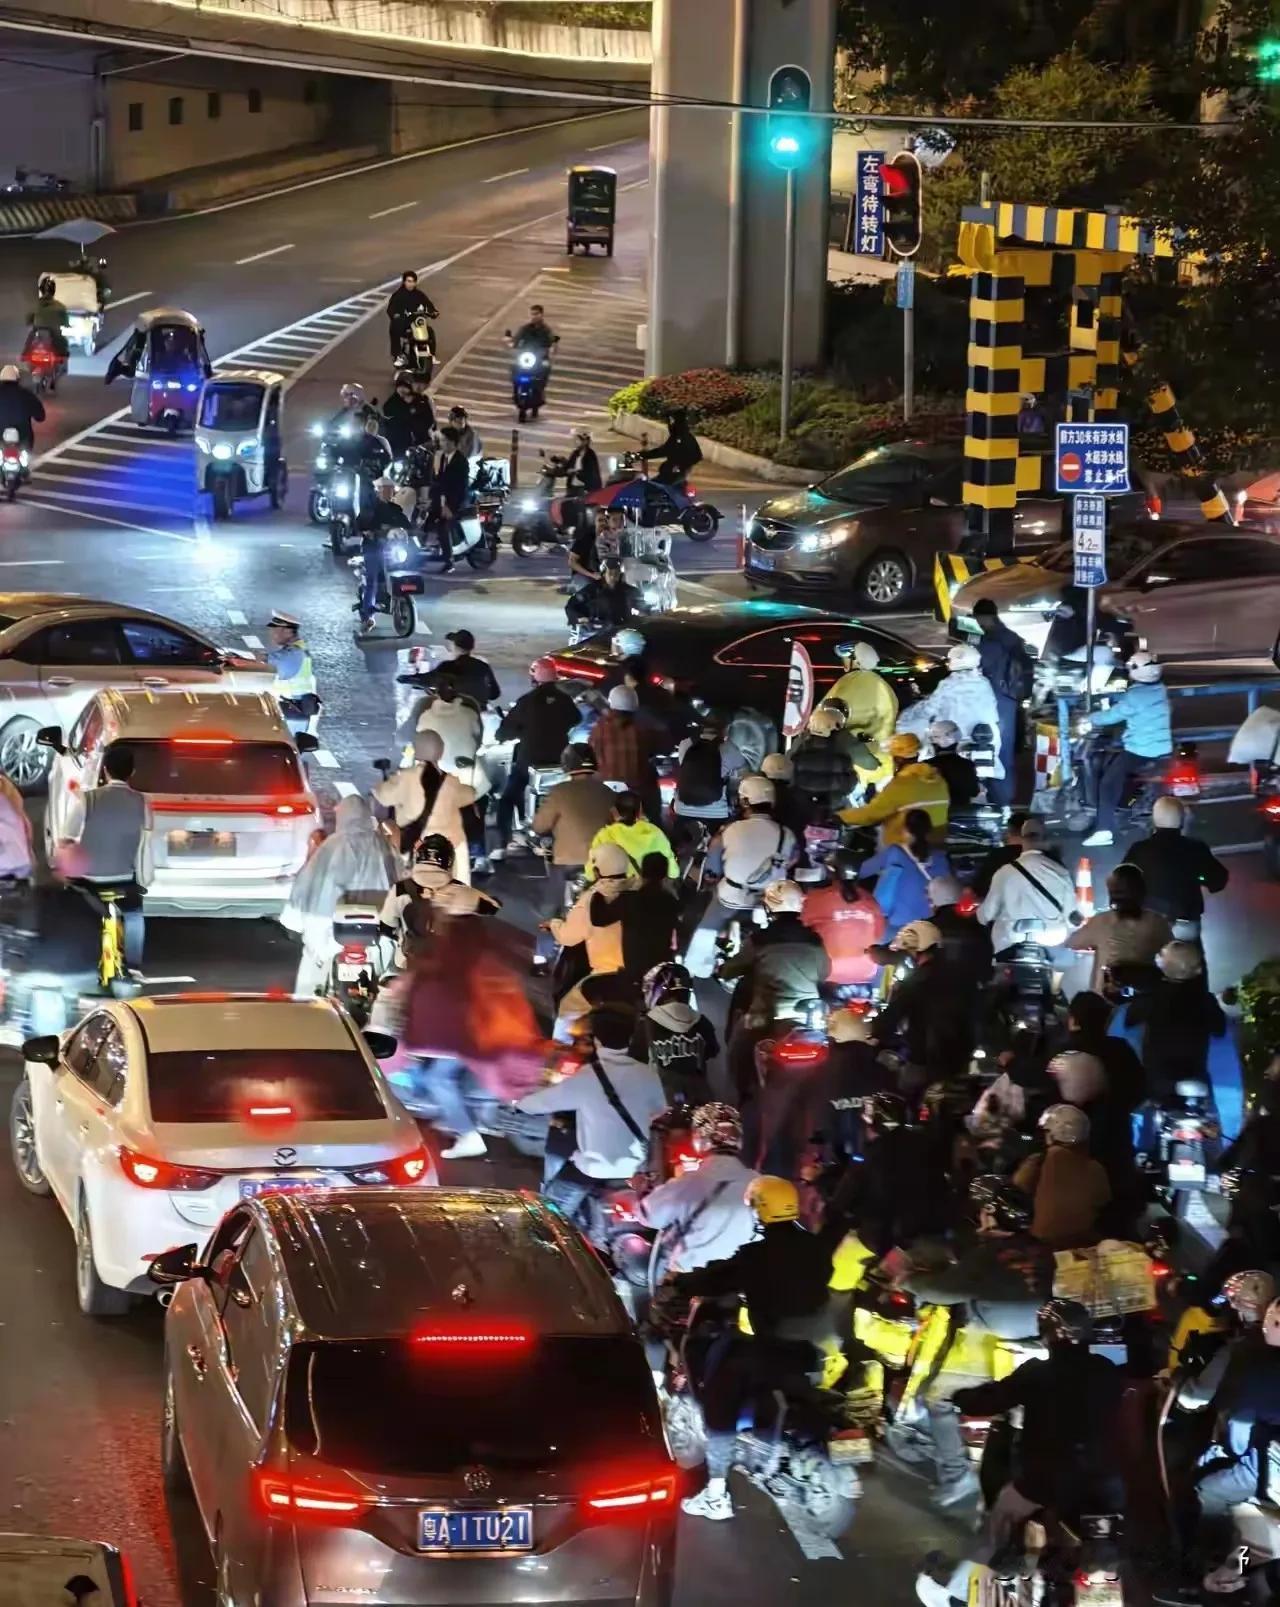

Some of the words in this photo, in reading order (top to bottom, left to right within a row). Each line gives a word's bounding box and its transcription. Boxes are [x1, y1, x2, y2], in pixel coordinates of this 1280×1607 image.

[861, 155, 880, 253] 左弯待转灯
